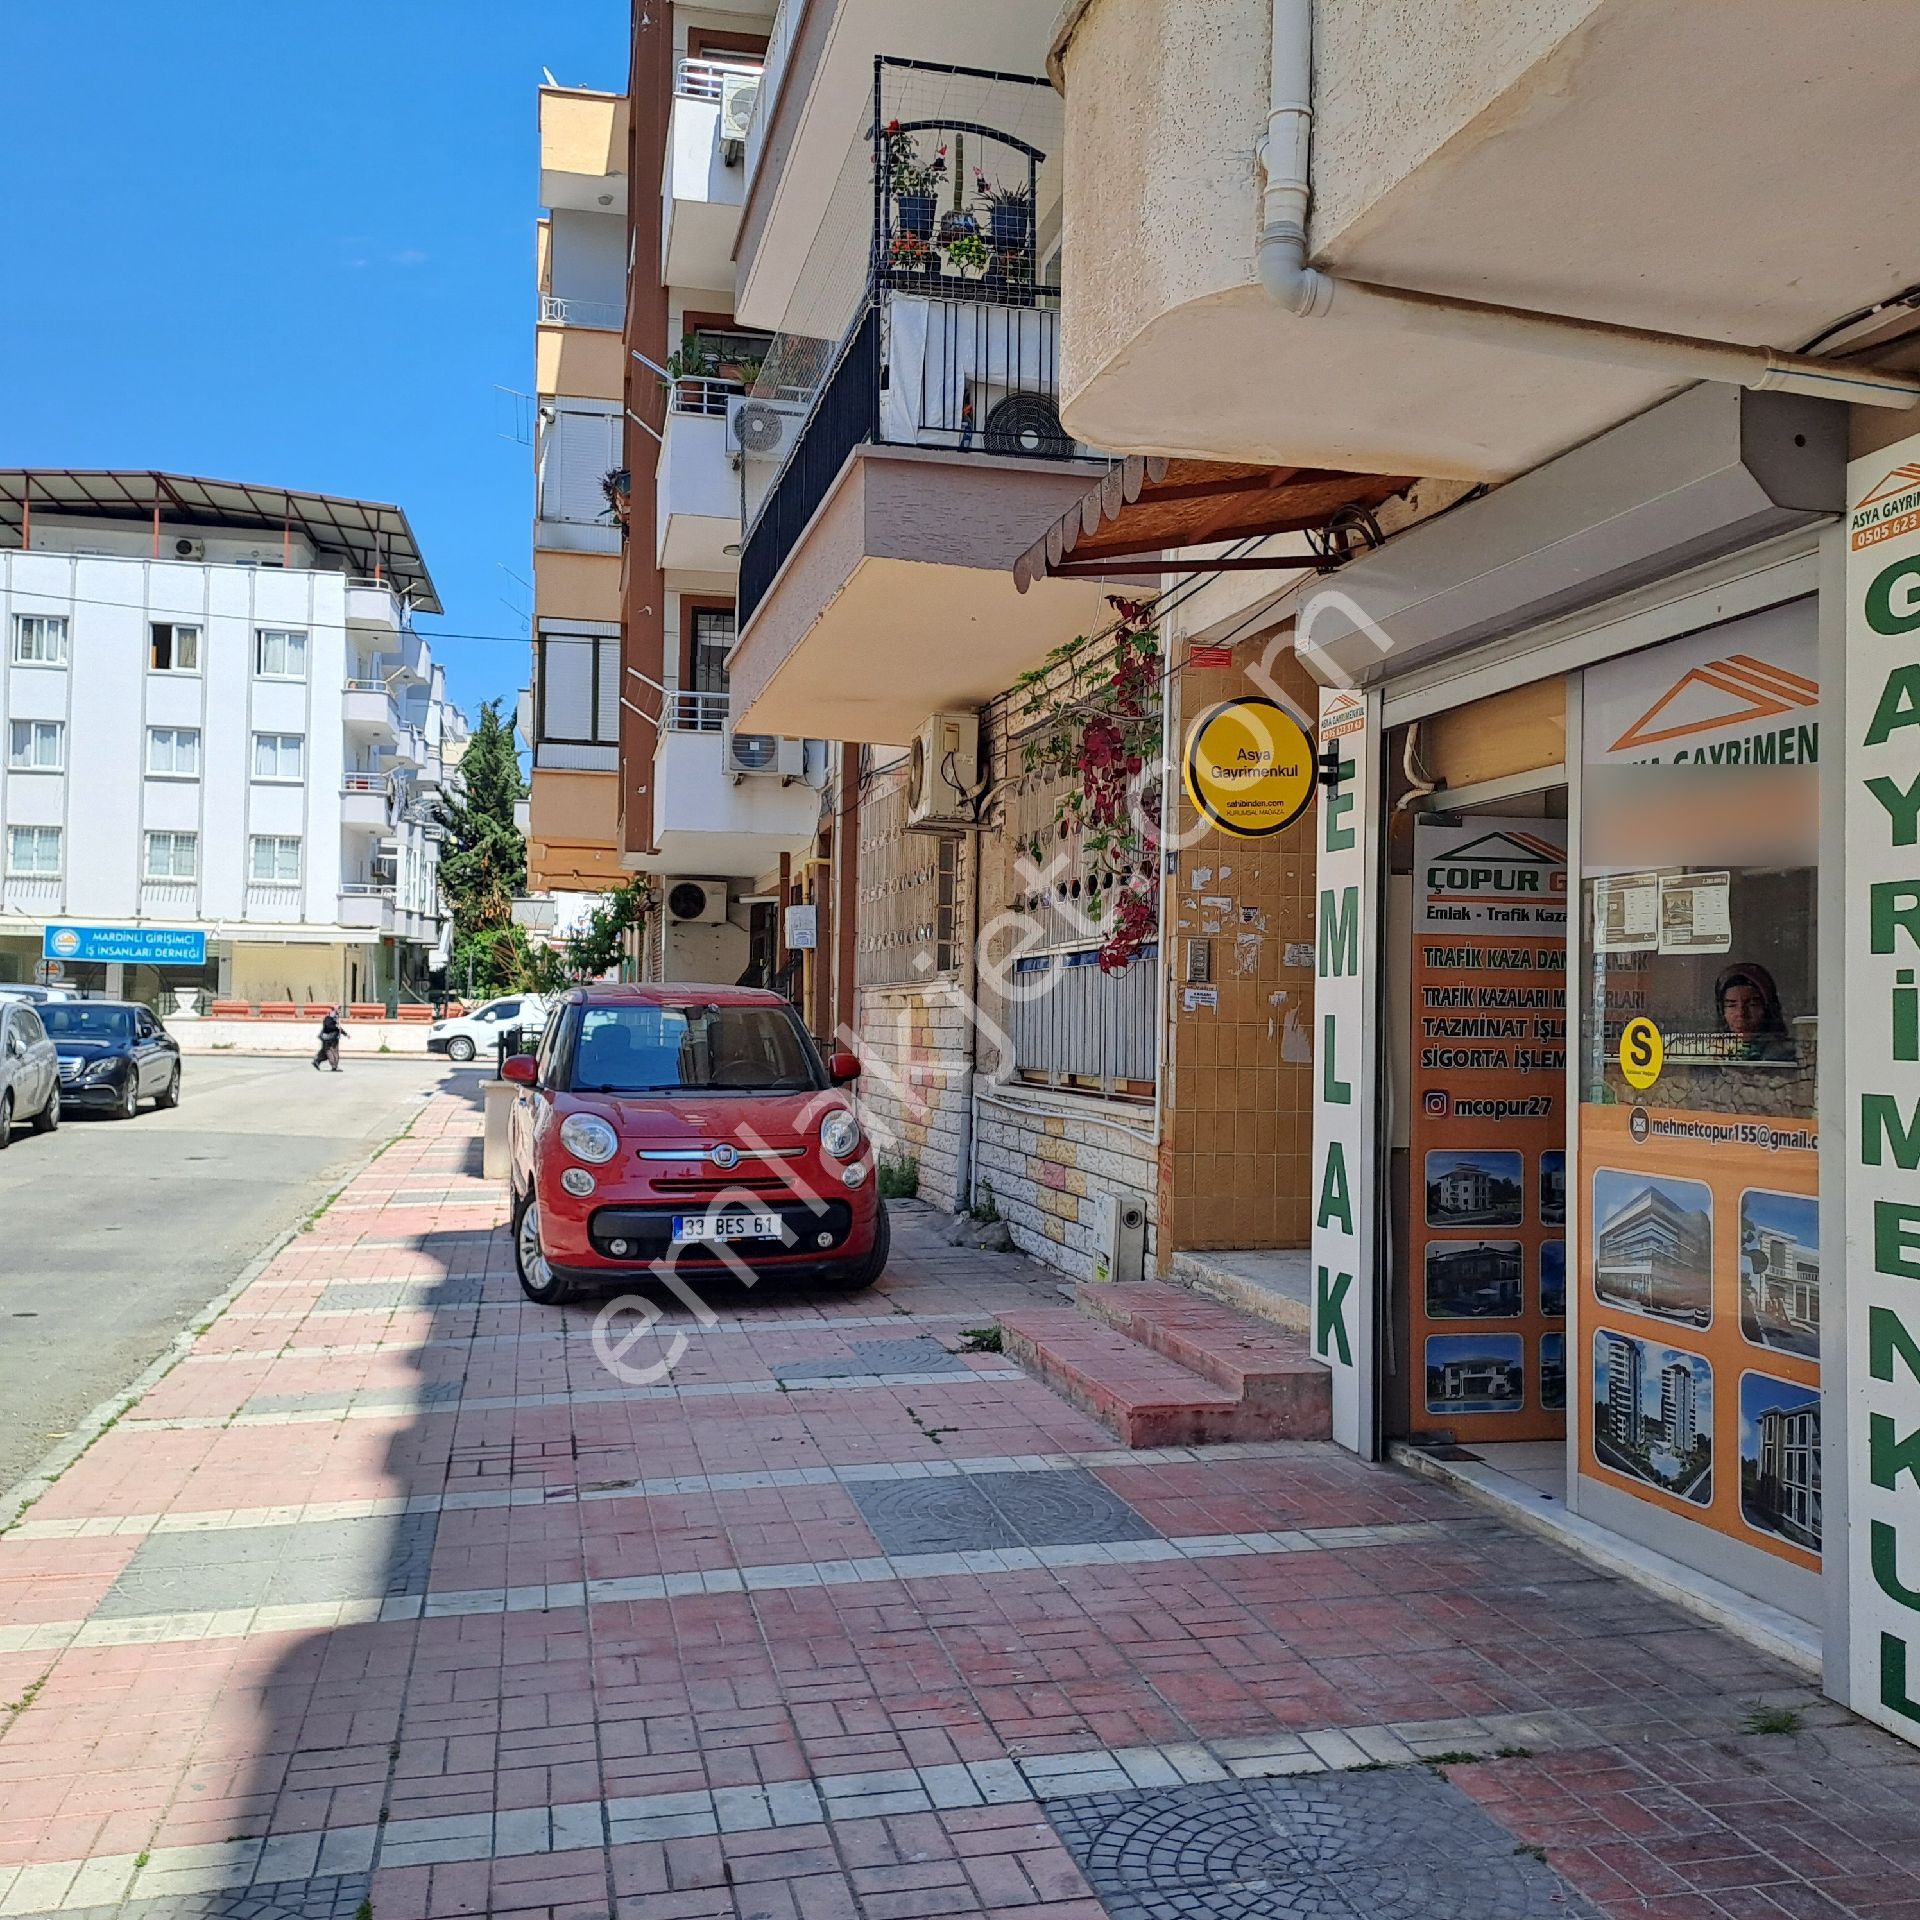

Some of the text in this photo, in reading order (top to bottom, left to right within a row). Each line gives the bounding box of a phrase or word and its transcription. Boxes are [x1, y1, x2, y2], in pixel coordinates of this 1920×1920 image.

[1852, 508, 1880, 530] ASYA
[1857, 513, 1918, 547] 0505 623
[1237, 747, 1271, 763] Asya
[1211, 764, 1299, 781] Gayrimenkul
[1226, 799, 1285, 808] sahibinden.com
[1427, 867, 1540, 895] ÇOPUR
[1426, 905, 1471, 921] Emlak
[1487, 906, 1530, 922] Trafik
[92, 931, 195, 946] MARDİNLİ GİRİŞİMCİ
[154, 947, 201, 960] DERNEĞİ
[1423, 941, 1483, 969] TRAFİK
[1487, 948, 1532, 970] KAZA
[1422, 981, 1474, 1007] TRAFİK
[1477, 986, 1549, 1008] KAZALARI
[1422, 1013, 1529, 1038] TAZMİNAT
[1421, 1043, 1509, 1068] SİGORTA
[1631, 1025, 1653, 1067] S
[1317, 758, 1358, 1368] EMLAK
[1454, 1096, 1552, 1122] mcopur27
[1652, 1118, 1819, 1152] mehmetcopur155@gmail.c
[684, 1218, 705, 1236] 33
[715, 1217, 745, 1235] BES
[753, 1216, 773, 1234] 61
